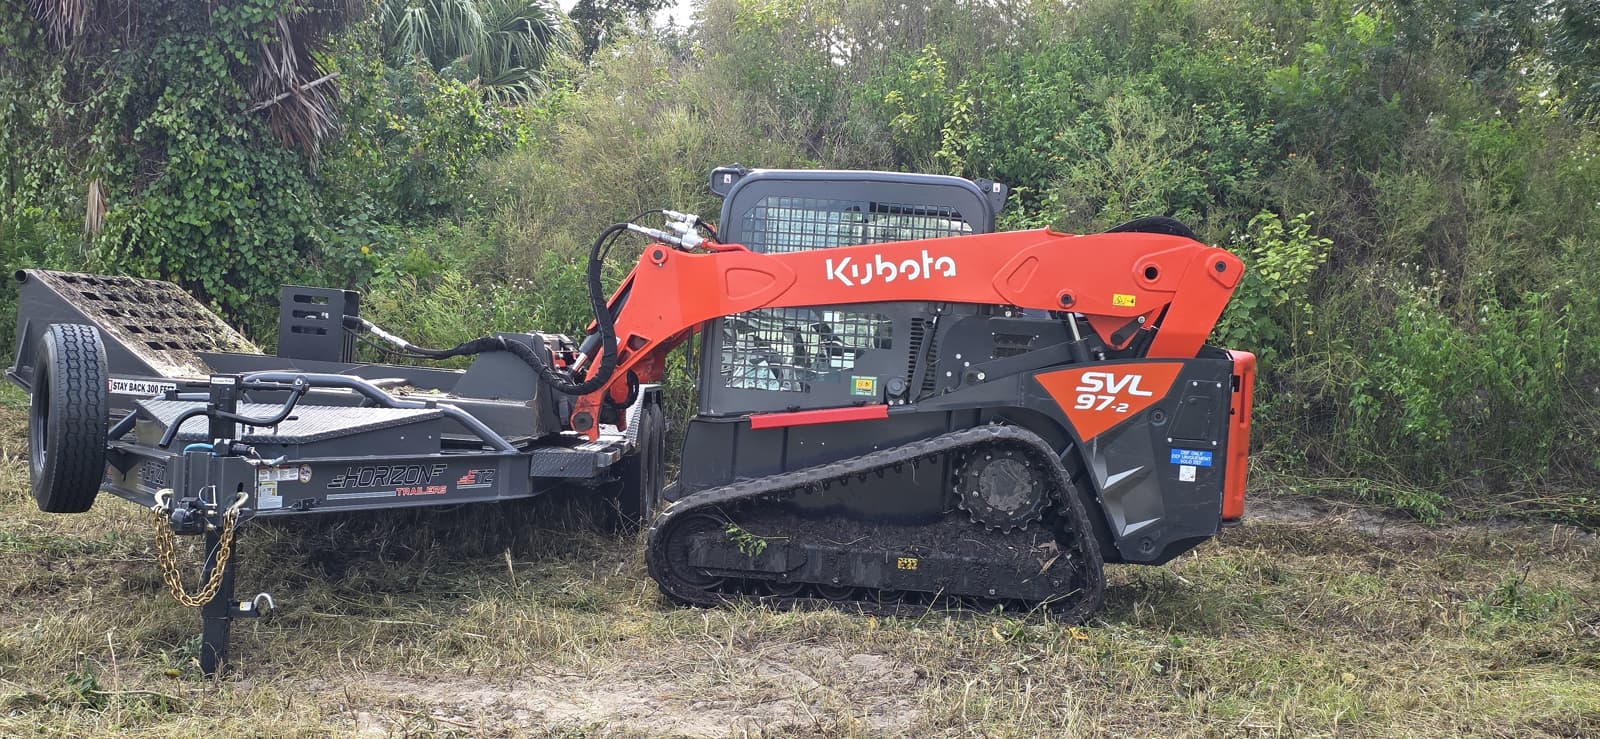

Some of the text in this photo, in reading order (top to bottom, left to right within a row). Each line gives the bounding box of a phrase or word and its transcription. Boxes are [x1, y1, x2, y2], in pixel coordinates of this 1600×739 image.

[826, 250, 956, 286] Kubota
[113, 381, 128, 391] STAY
[129, 383, 146, 392] BACK
[147, 384, 159, 393] 300
[1076, 372, 1153, 396] SVL
[1074, 394, 1129, 412] 97-2
[328, 464, 447, 489] HORIZON
[395, 485, 447, 497] TRAILERS
